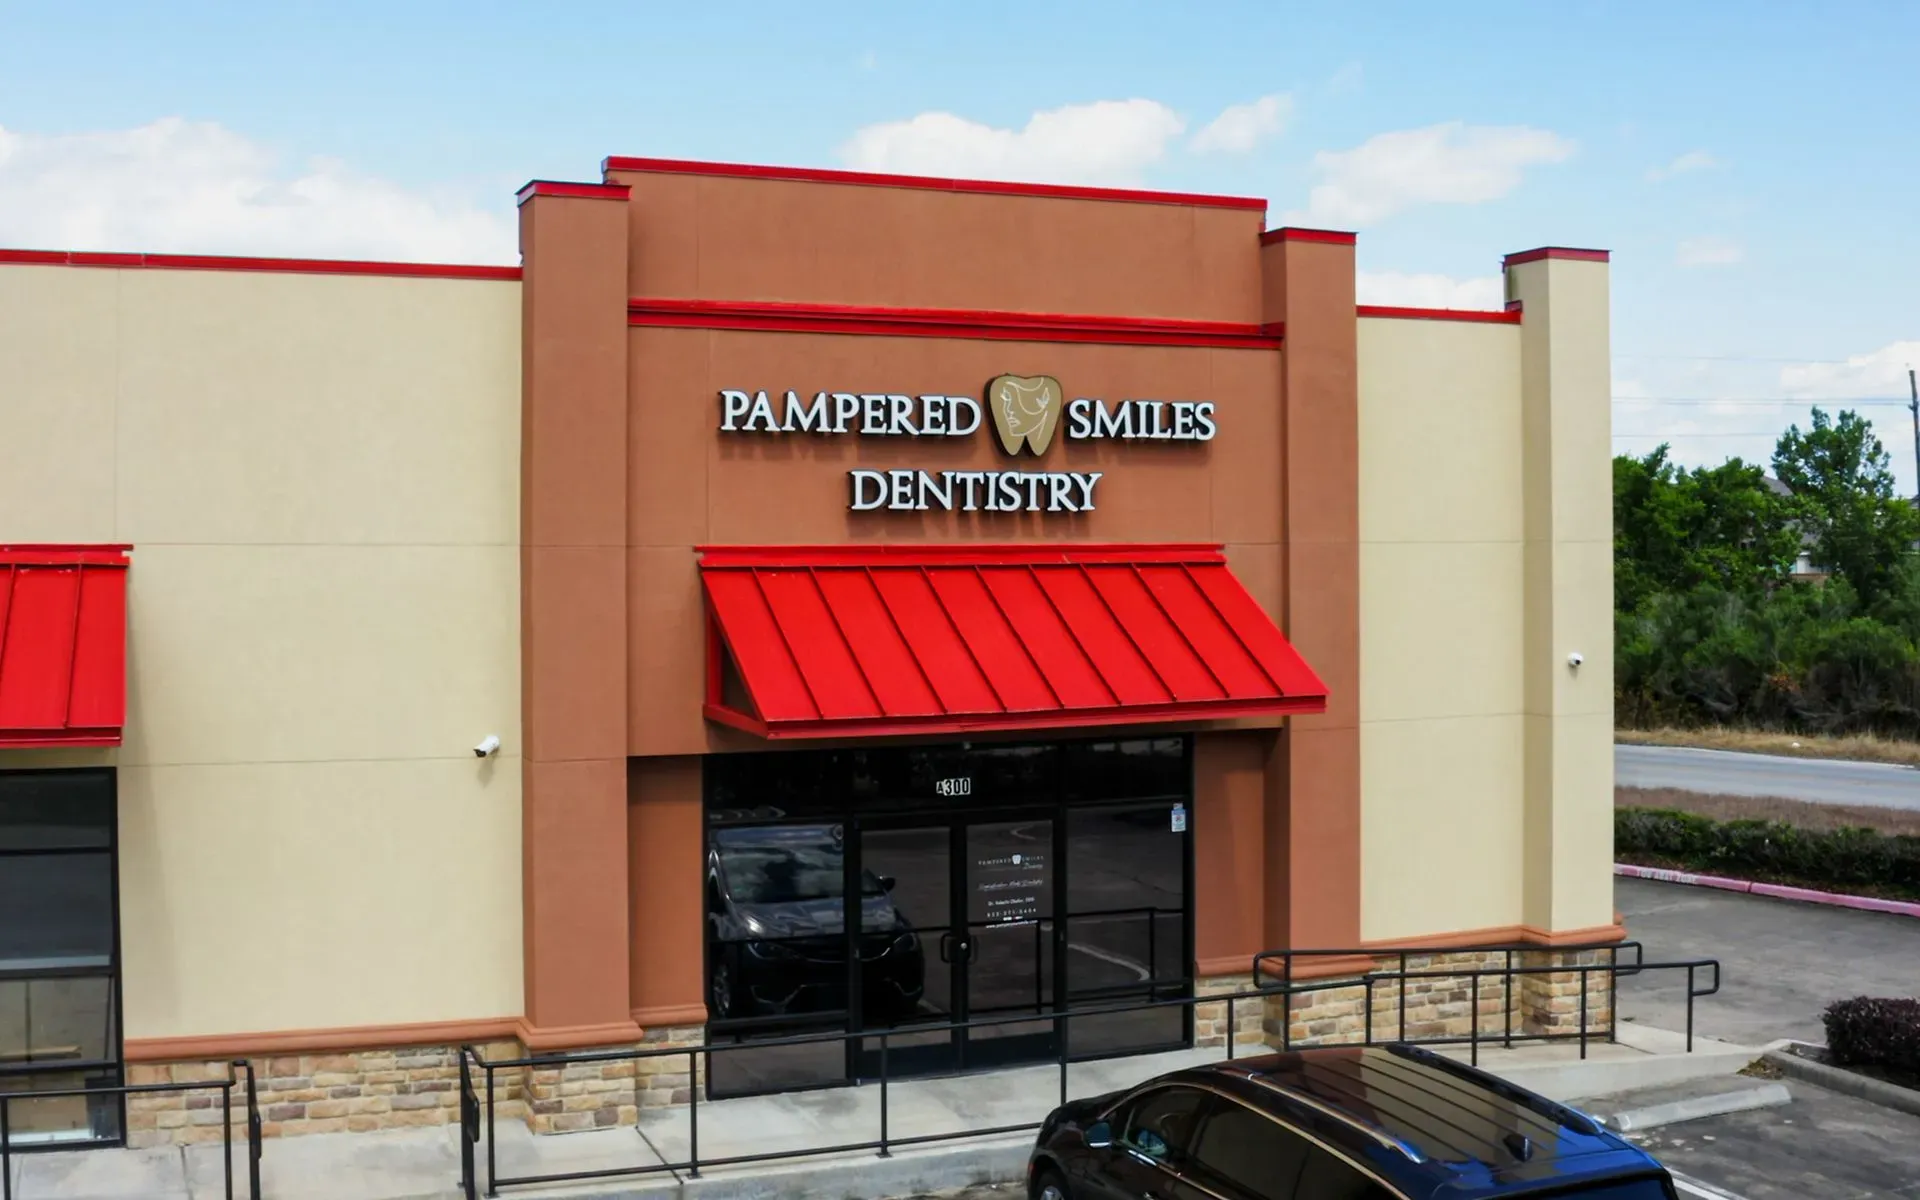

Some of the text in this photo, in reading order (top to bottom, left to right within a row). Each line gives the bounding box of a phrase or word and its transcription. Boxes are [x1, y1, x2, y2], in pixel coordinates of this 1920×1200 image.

[719, 389, 1217, 441] PAMPERED SMILES
[849, 469, 1103, 512] DENTISTRY
